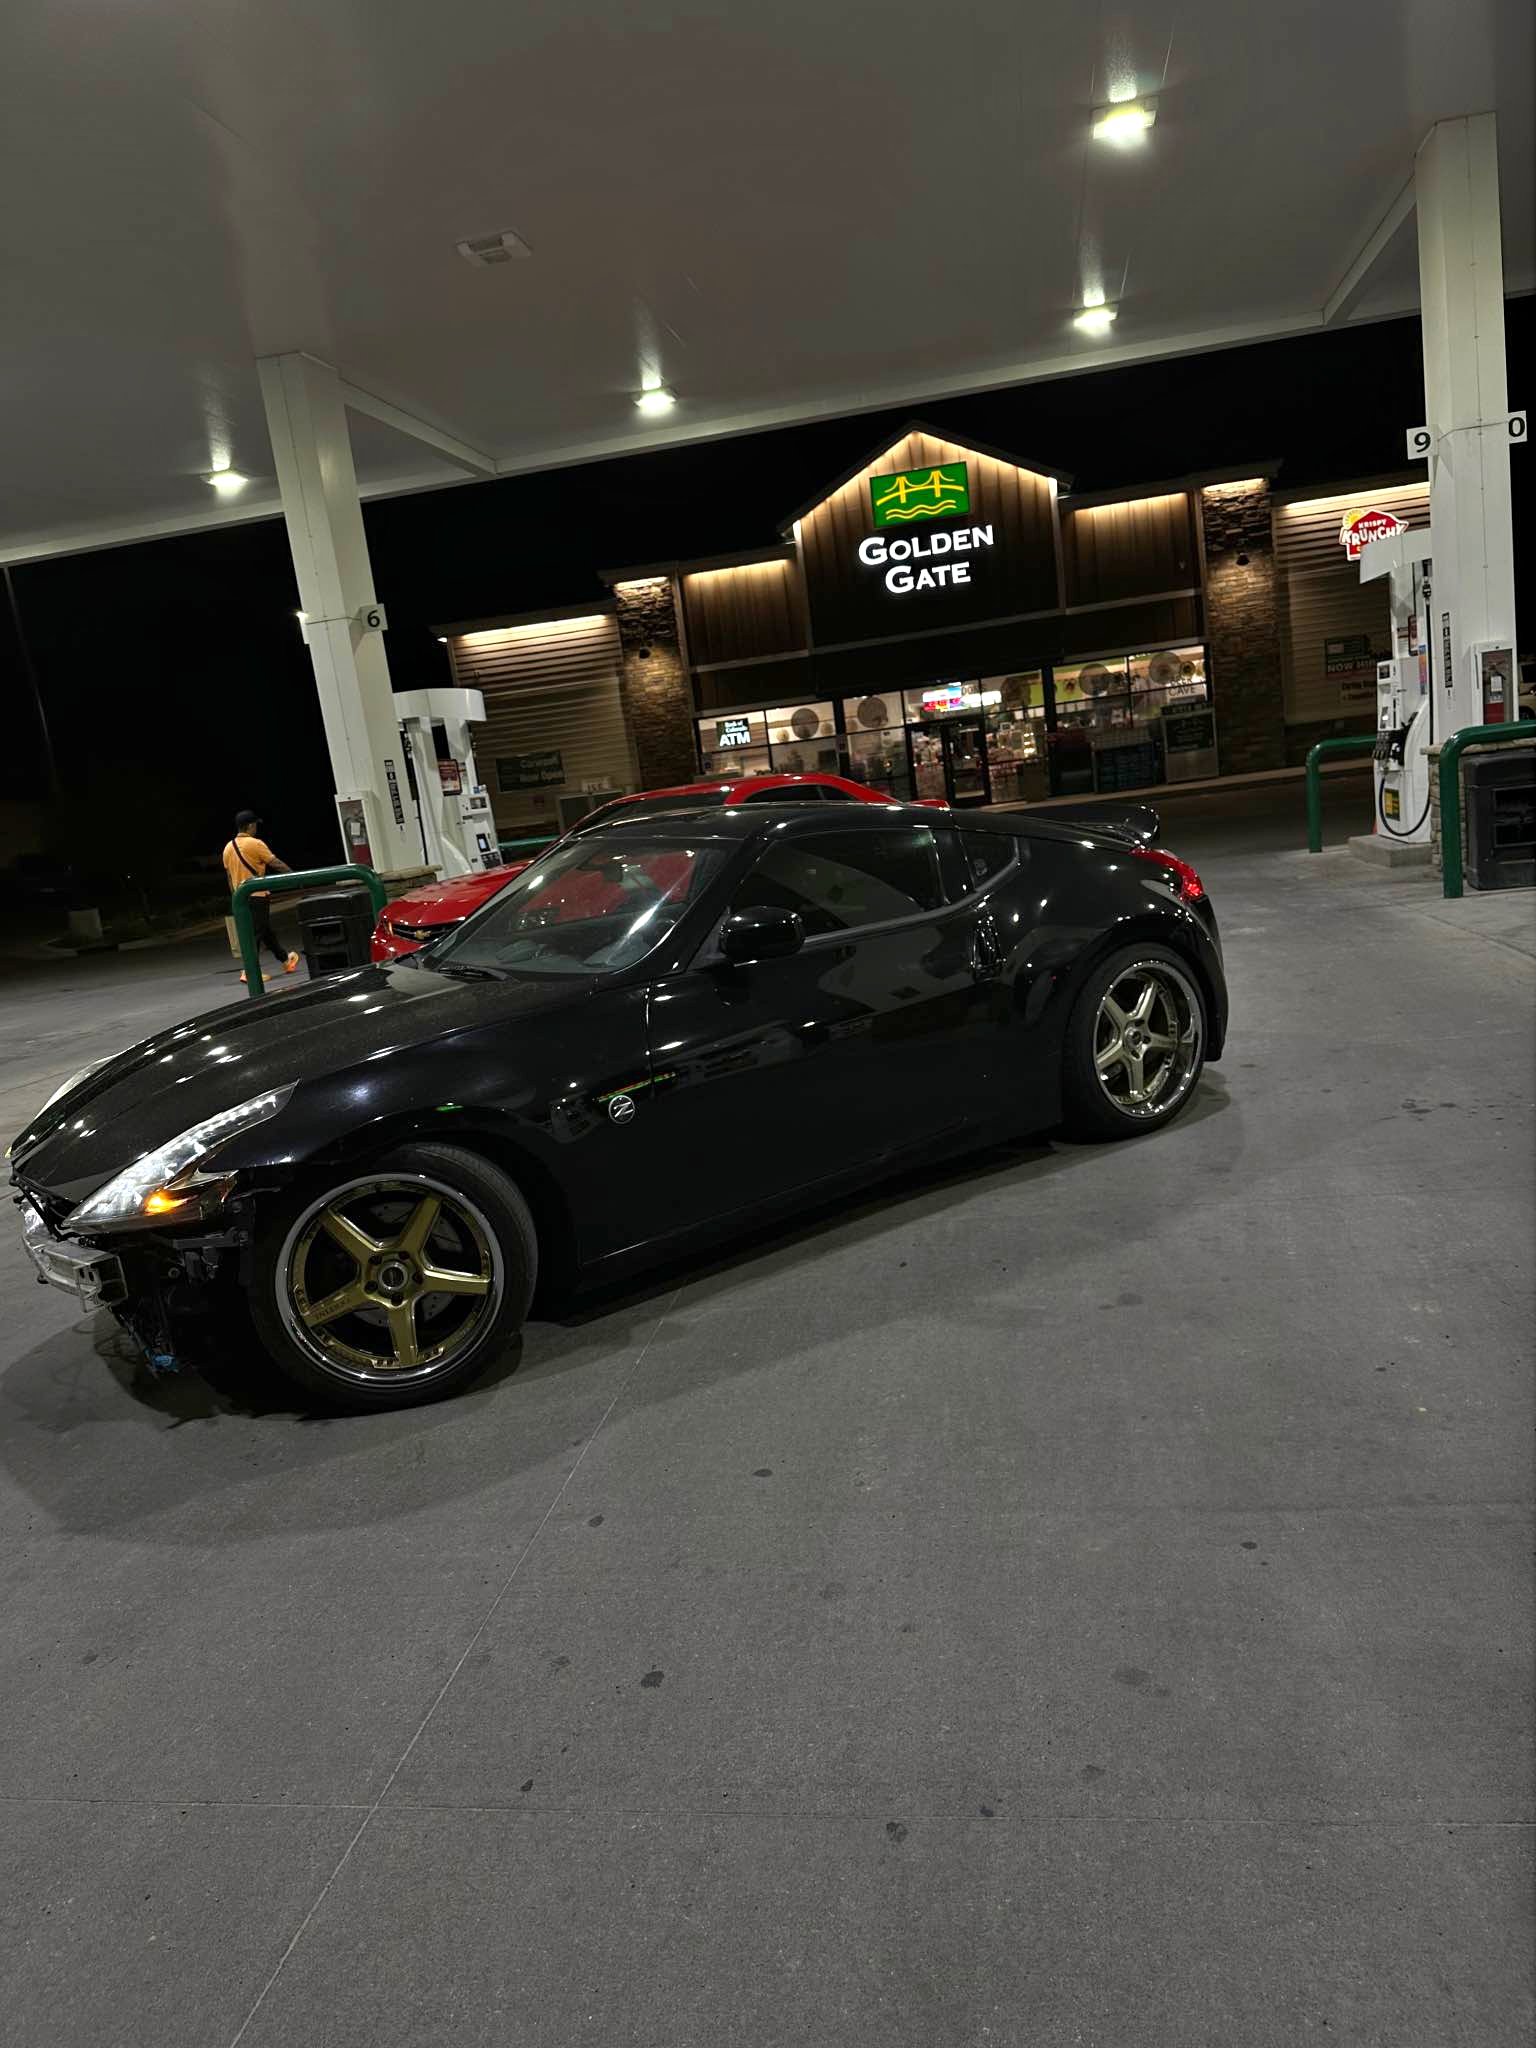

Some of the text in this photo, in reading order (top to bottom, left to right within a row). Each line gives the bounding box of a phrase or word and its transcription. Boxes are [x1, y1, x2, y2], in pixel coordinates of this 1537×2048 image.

[1414, 431, 1432, 453] 9
[1341, 523, 1406, 546] KRUNCHY
[1358, 518, 1387, 529] KRISPY
[858, 524, 994, 566] GOLDEN
[885, 561, 972, 594] GATE
[367, 609, 380, 628] 6
[720, 731, 751, 746] ATM
